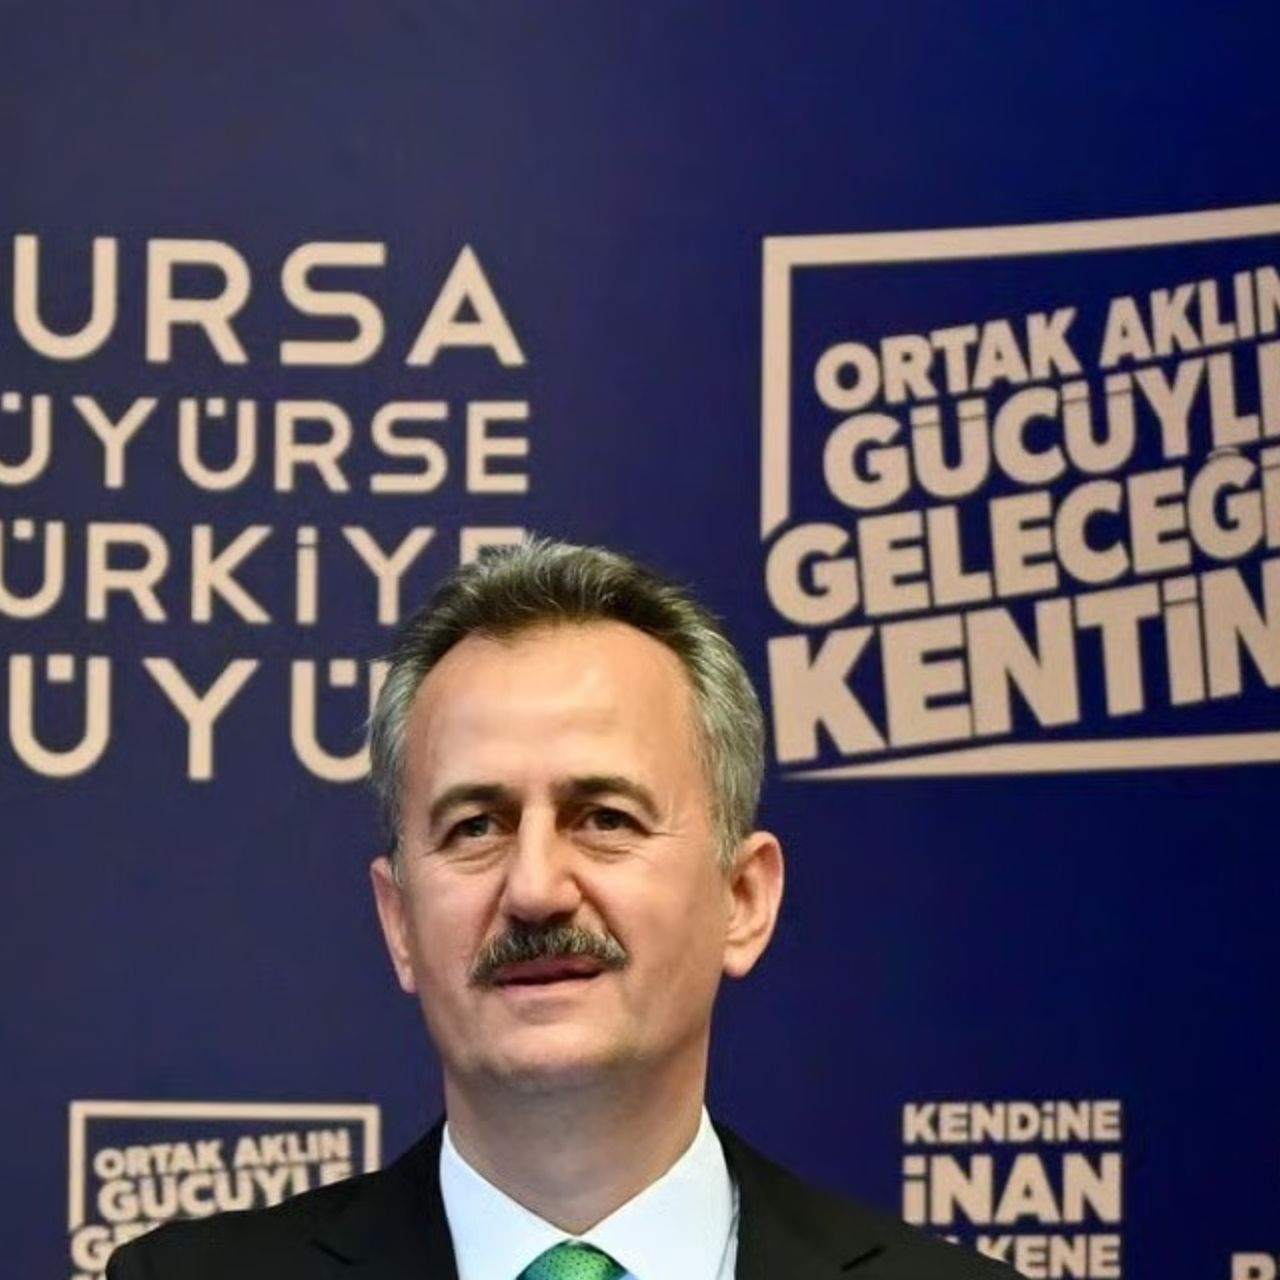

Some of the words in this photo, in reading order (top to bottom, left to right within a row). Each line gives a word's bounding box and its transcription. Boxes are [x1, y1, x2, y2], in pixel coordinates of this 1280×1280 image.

[814, 305, 1084, 412] ORTAK
[902, 1101, 1121, 1144] KENDİNE
[93, 1139, 223, 1181] ORTAK
[233, 1128, 351, 1170] AKLIN
[902, 1152, 1121, 1226] İNAN
